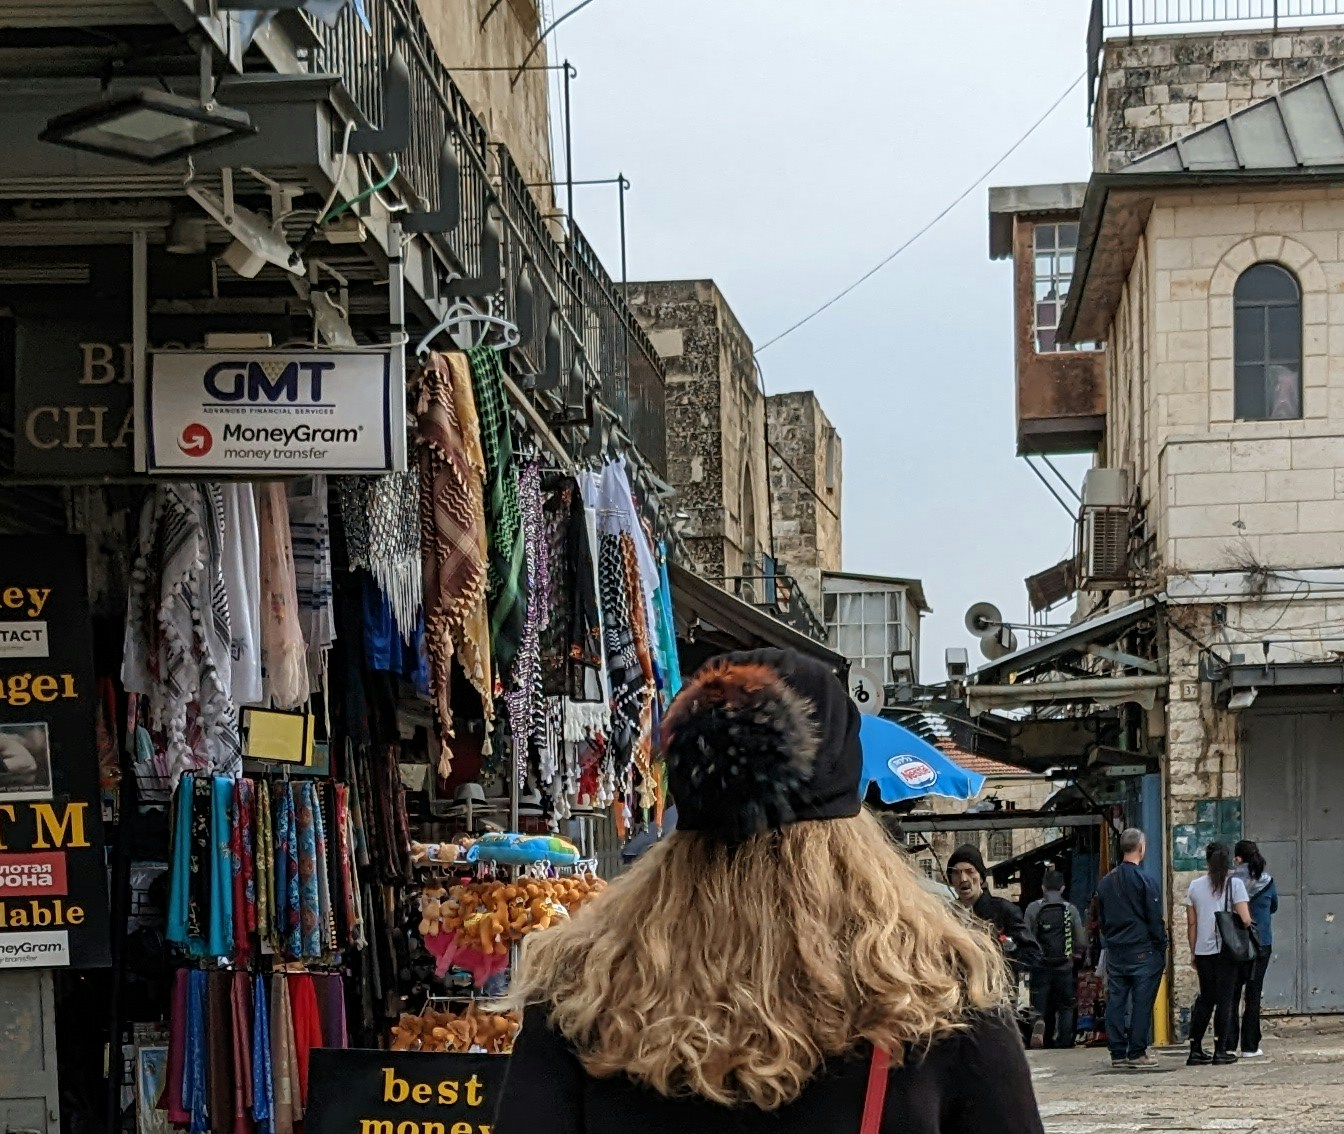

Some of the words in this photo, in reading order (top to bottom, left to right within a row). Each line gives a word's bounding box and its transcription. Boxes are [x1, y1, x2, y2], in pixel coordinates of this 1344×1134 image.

[202, 360, 336, 403] GMT
[222, 423, 358, 447] MoneyGram
[224, 448, 271, 462] money
[273, 447, 329, 460] transfer
[381, 1067, 484, 1107] best
